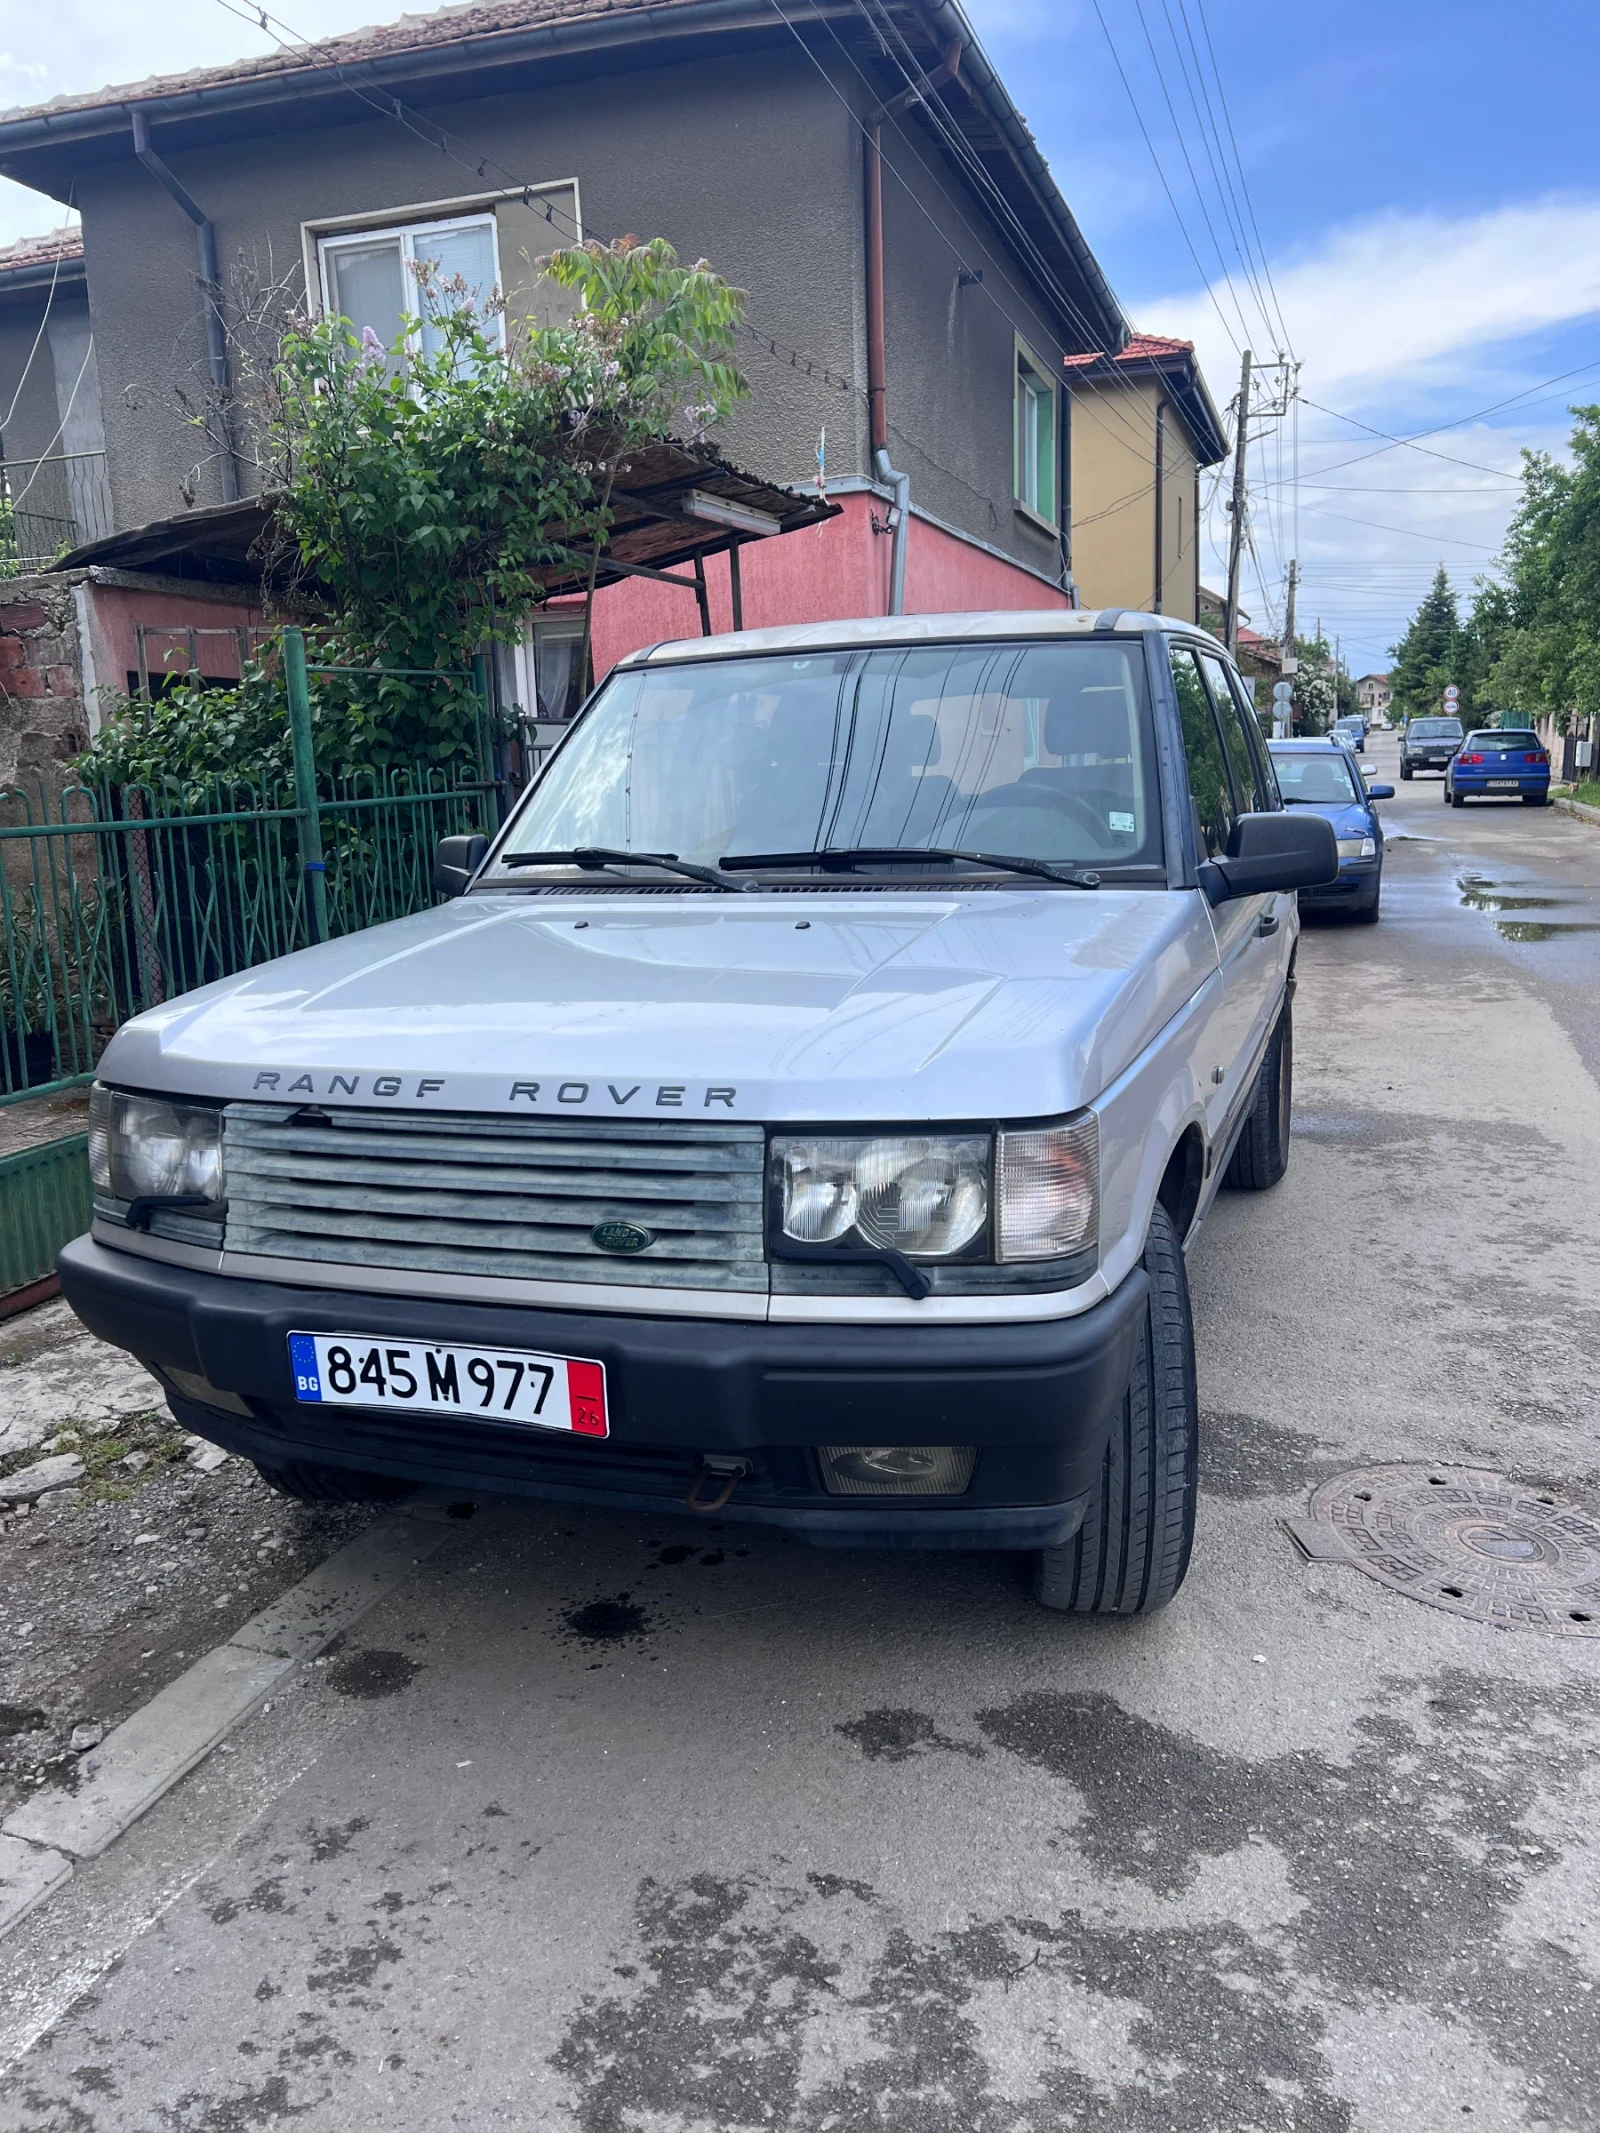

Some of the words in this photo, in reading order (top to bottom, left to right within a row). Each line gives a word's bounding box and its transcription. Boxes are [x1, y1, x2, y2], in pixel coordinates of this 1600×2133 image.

[509, 1081, 738, 1108] ROVER
[602, 1227, 630, 1237] LAND
[604, 1236, 639, 1247] ROVER
[297, 1375, 319, 1392] BG
[578, 1406, 600, 1427] 26
